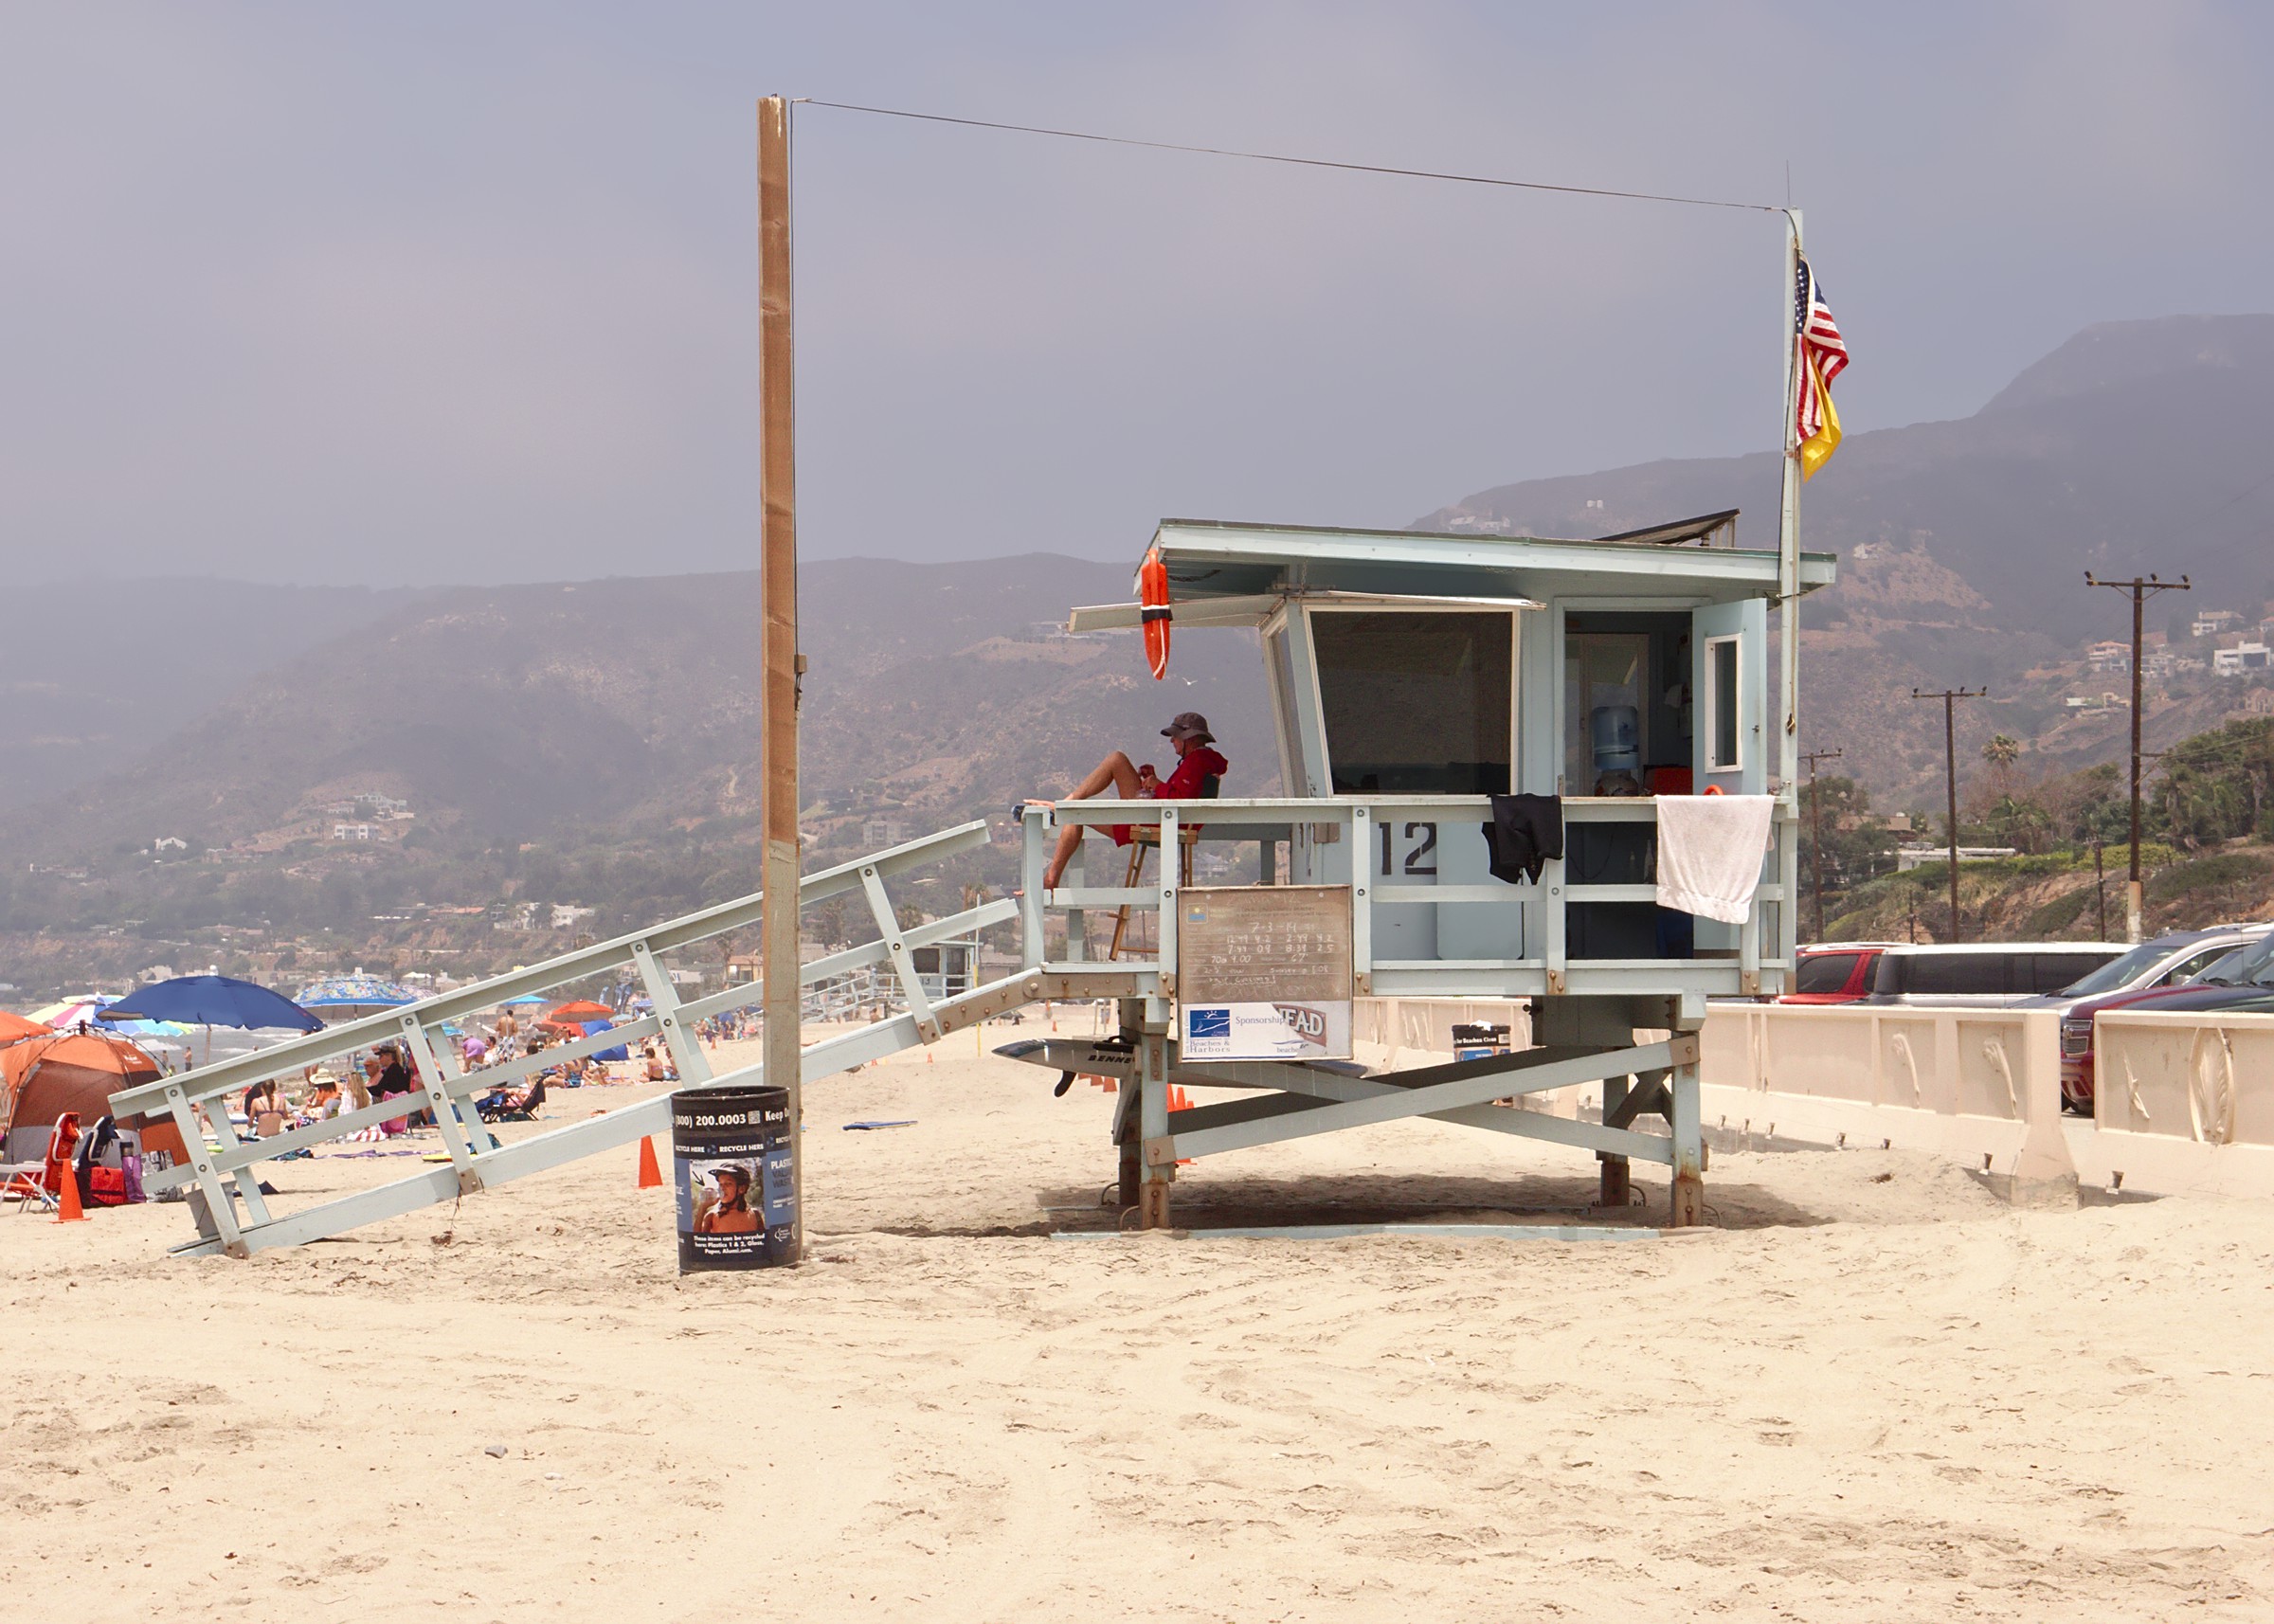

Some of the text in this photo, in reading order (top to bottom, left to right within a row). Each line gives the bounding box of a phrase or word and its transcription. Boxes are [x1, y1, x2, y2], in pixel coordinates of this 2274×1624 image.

[1379, 821, 1437, 875] 12
[1236, 1016, 1285, 1026] Sponsorship
[1088, 1055, 1135, 1063] BENNE
[695, 1113, 747, 1127] 200.0003
[765, 1110, 784, 1123] Keep
[718, 1144, 748, 1153] RECYCLE
